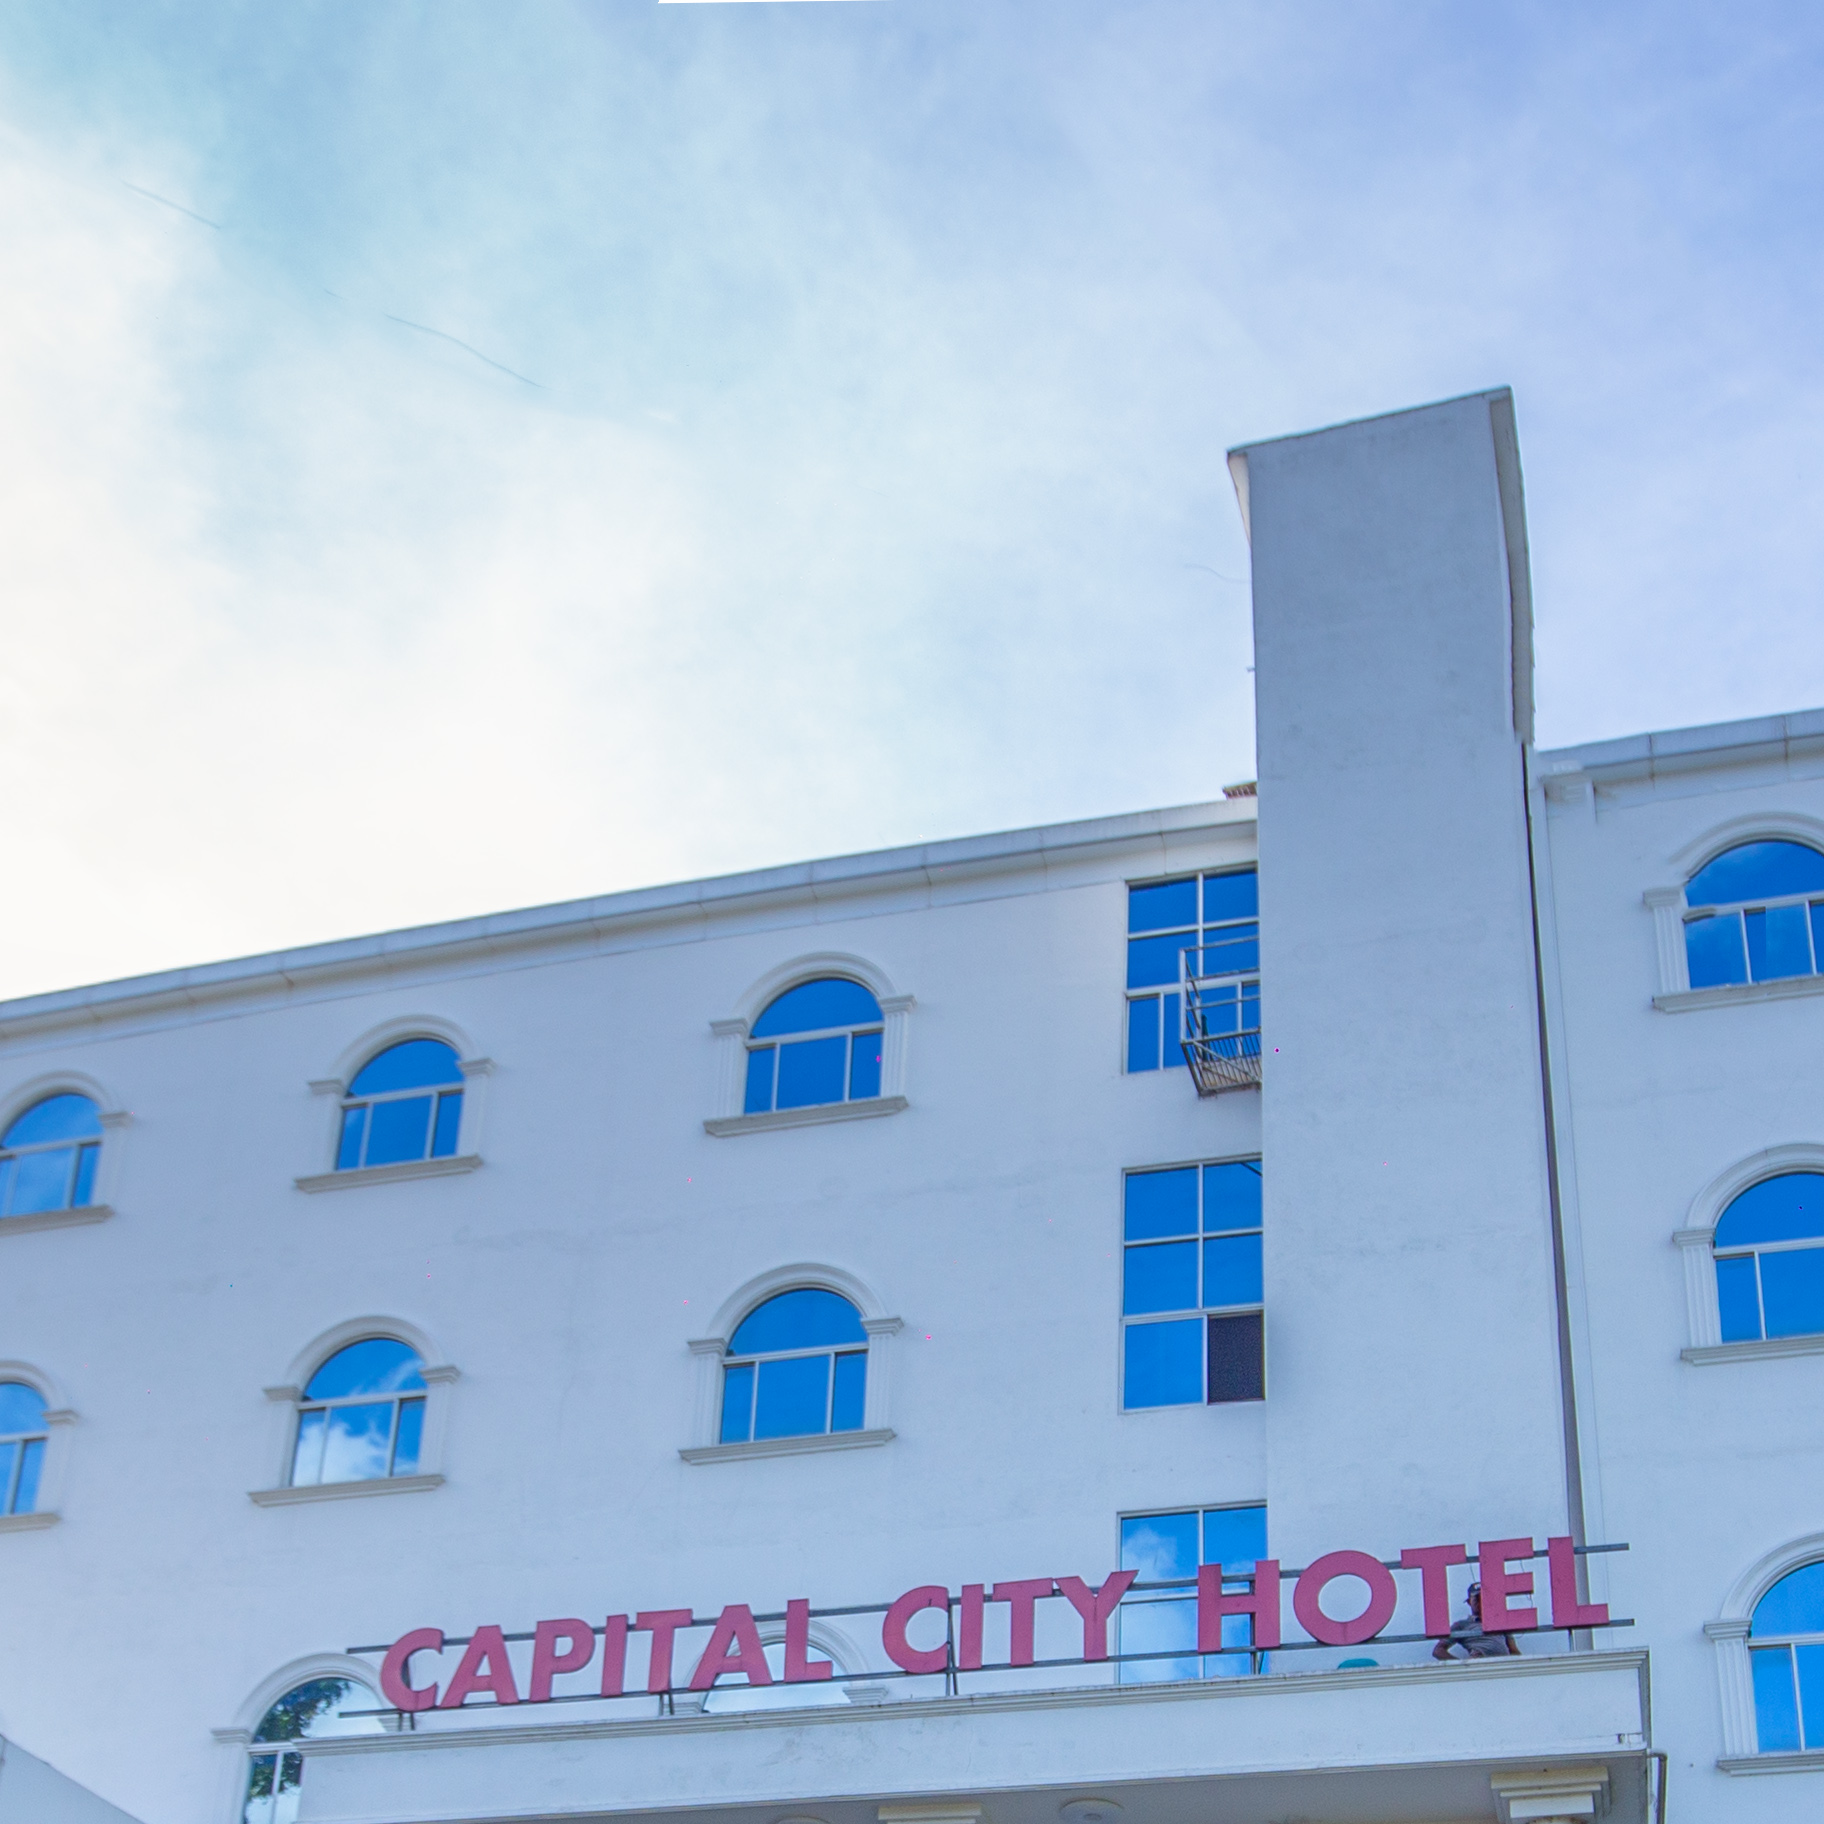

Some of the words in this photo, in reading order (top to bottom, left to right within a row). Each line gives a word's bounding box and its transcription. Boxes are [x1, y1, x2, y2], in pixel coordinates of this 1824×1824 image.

[379, 1597, 834, 1713] CAPITAL
[882, 1569, 1140, 1675] CITY
[1197, 1535, 1611, 1654] HOTEL
